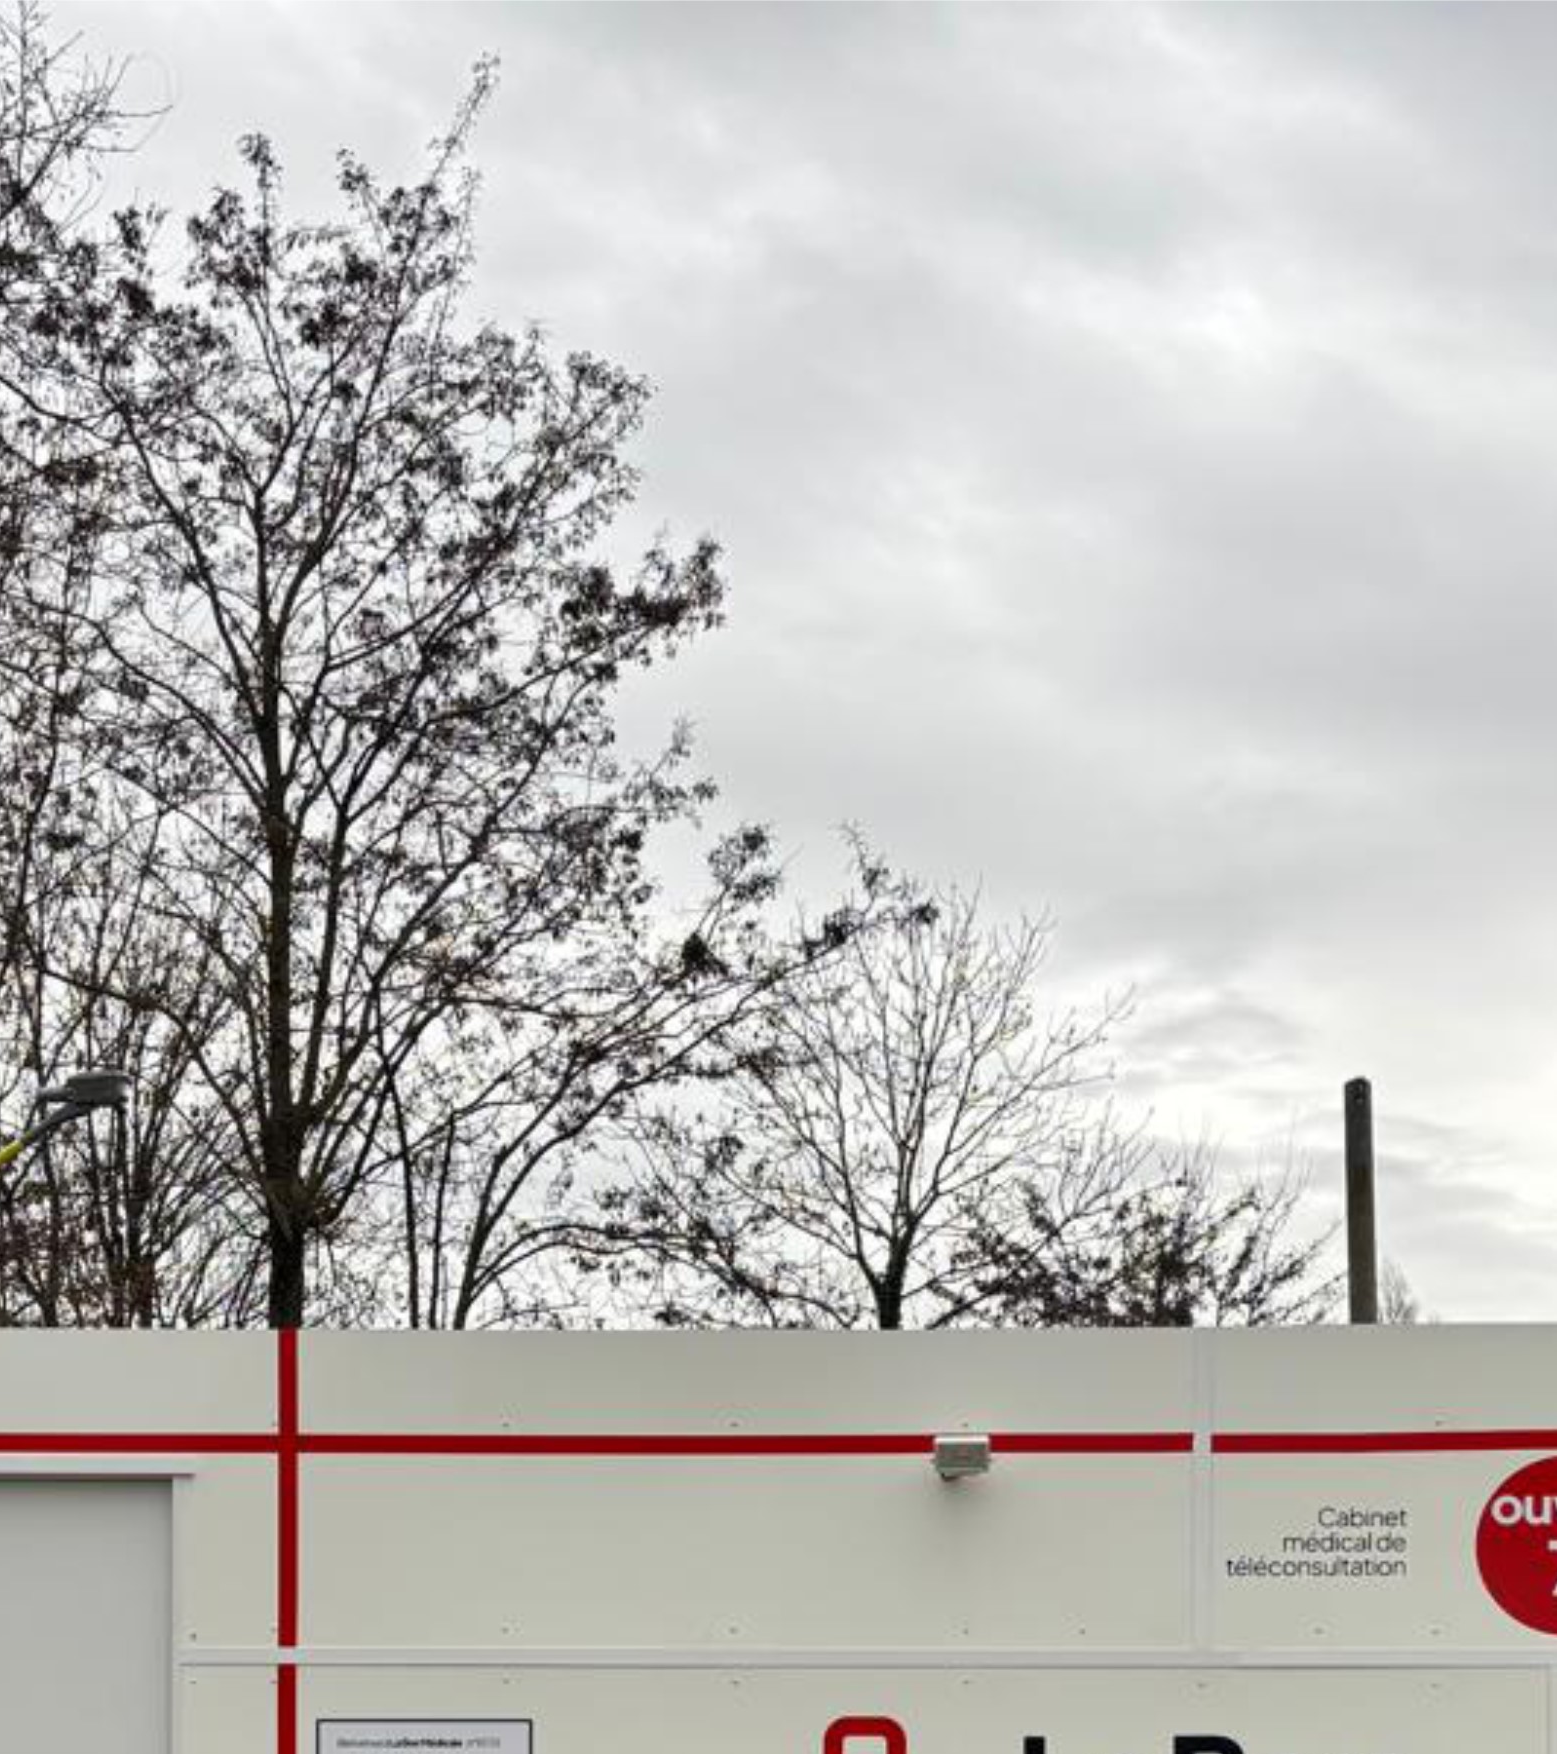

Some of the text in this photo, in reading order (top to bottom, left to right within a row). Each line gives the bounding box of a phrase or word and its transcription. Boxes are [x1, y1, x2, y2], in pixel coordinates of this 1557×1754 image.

[1317, 1505, 1407, 1528] Cabinet
[1282, 1531, 1407, 1553] médical de
[1226, 1555, 1408, 1577] téléconsultation
